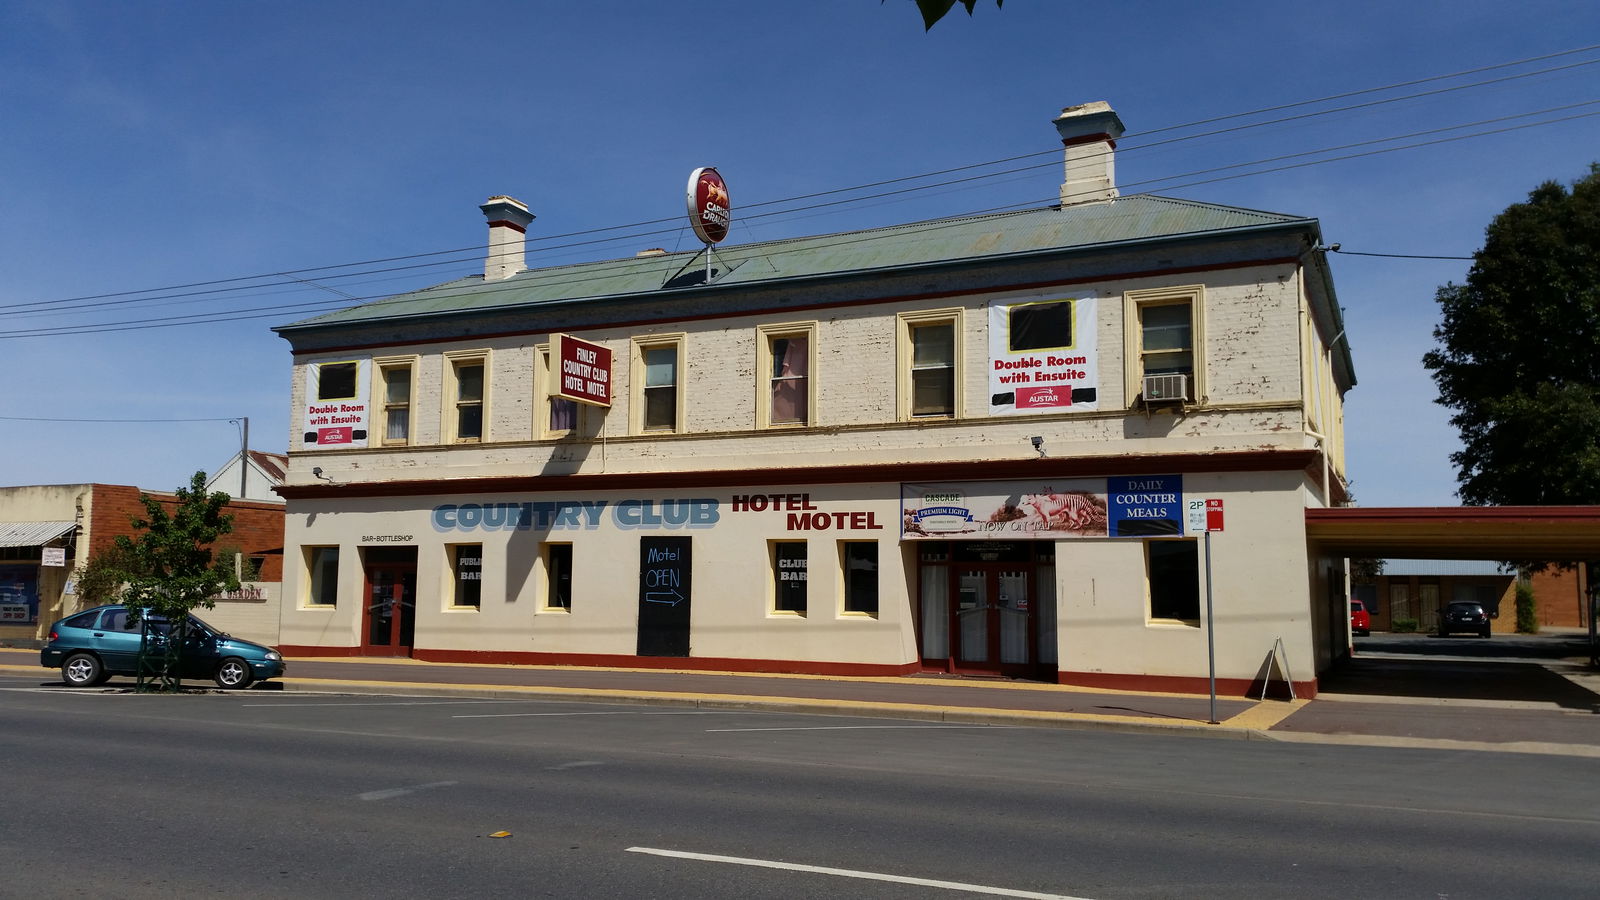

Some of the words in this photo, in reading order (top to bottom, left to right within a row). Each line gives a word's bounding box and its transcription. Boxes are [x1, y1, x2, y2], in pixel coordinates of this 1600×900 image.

[706, 202, 729, 218] CARLTO
[576, 347, 597, 364] FINLEY
[994, 357, 1042, 370] Double
[1047, 356, 1087, 366] Room
[563, 359, 592, 378] COUNTRY
[592, 367, 608, 382] CLUB
[999, 372, 1030, 384] with
[1035, 369, 1086, 382] Ensuite
[565, 375, 584, 392] HOTEL
[587, 381, 606, 397] MOTEL
[1028, 395, 1059, 403] AUSTAR
[309, 404, 338, 414] Double
[340, 404, 364, 412] Room
[310, 416, 329, 425] with
[331, 414, 361, 424] Ensuite
[1128, 480, 1164, 490] DAILY
[732, 493, 817, 512] HOTEL
[925, 493, 960, 502] CASCADE
[1116, 493, 1176, 504] COUNTER
[1190, 501, 1204, 510] 2P
[431, 500, 608, 532] COUNTRY
[612, 498, 720, 531] CLUB
[920, 507, 948, 516] PREMIUM
[949, 508, 966, 516] LIGHT
[1127, 507, 1167, 518] MEALS
[787, 512, 883, 530] MOTEL
[978, 521, 1007, 532] NOW
[1010, 521, 1028, 532] ON
[1028, 521, 1054, 531] TAP
[460, 557, 481, 565] PUBLI
[647, 547, 680, 564] Motel
[778, 559, 807, 568] CLUB
[460, 571, 481, 580] BAR
[646, 568, 680, 588] OPEN
[780, 571, 807, 581] BAR
